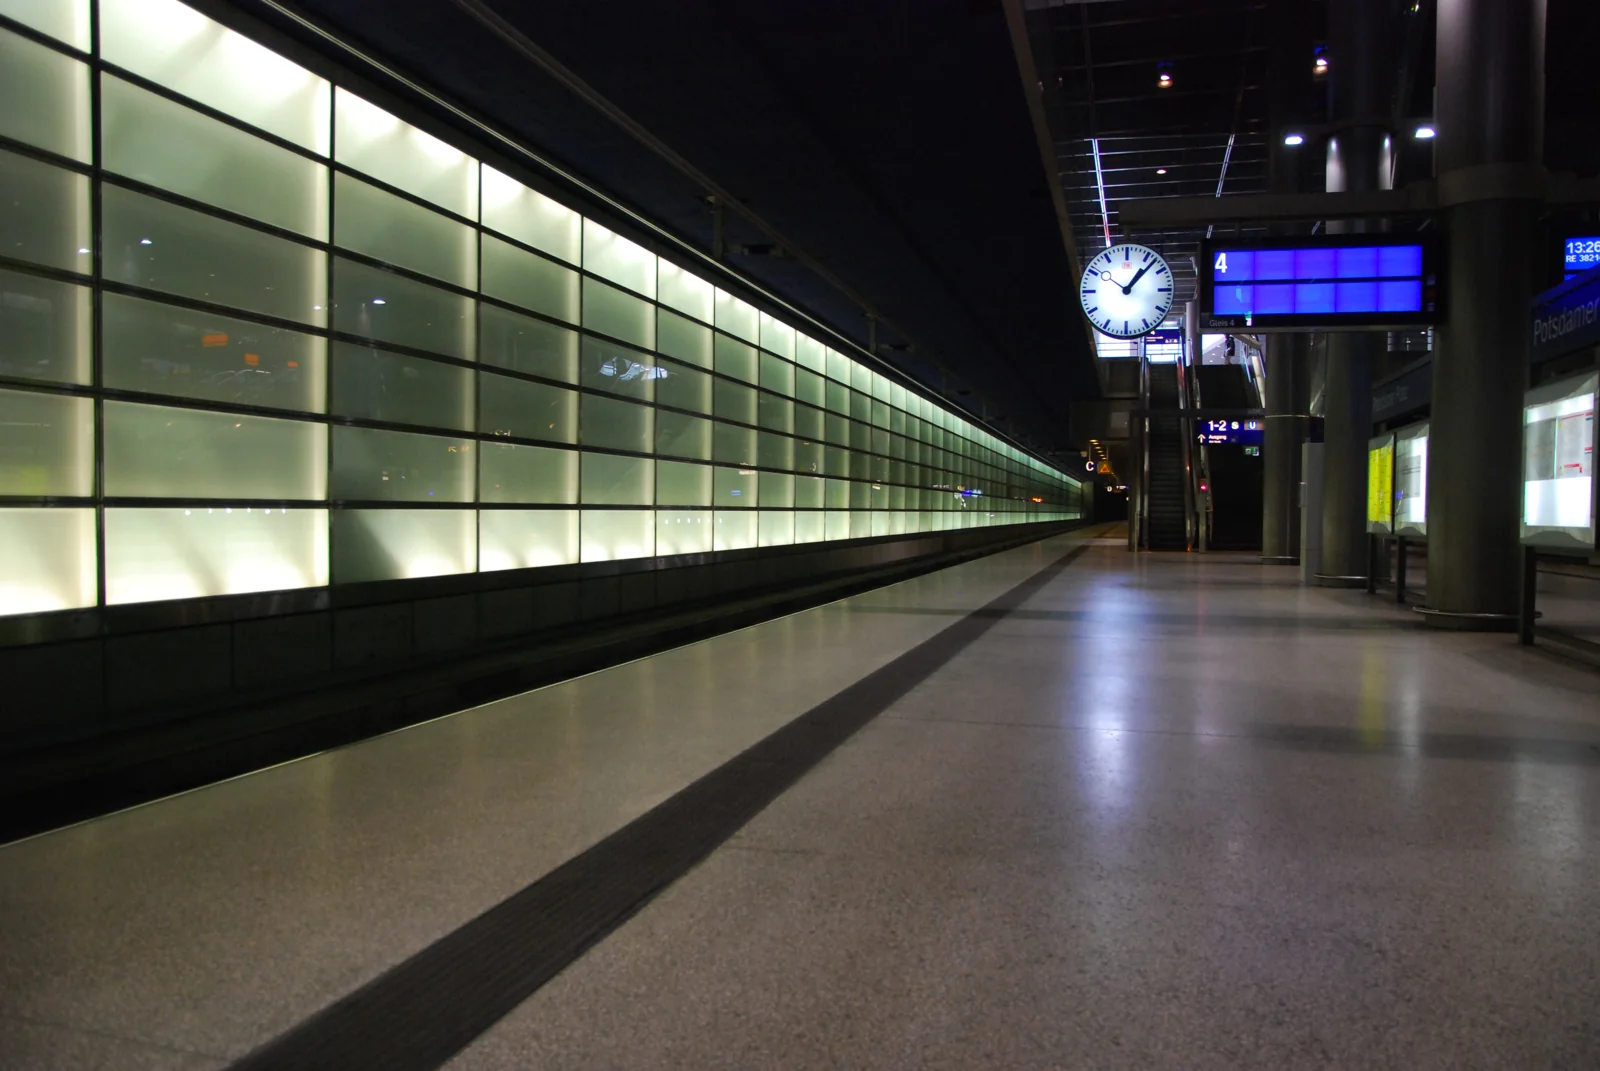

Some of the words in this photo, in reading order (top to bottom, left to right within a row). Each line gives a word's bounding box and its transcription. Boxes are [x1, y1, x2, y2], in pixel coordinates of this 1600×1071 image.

[1567, 241, 1600, 254] 13:26
[1214, 252, 1227, 273] 4
[1565, 254, 1577, 263] RE
[1579, 254, 1600, 262] 3821
[1209, 319, 1229, 327] Gleis
[1229, 319, 1236, 327] 4
[1533, 297, 1600, 347] Potsdamer
[1208, 419, 1227, 431] 1-2
[1231, 421, 1240, 430] S
[1085, 460, 1095, 472] C
